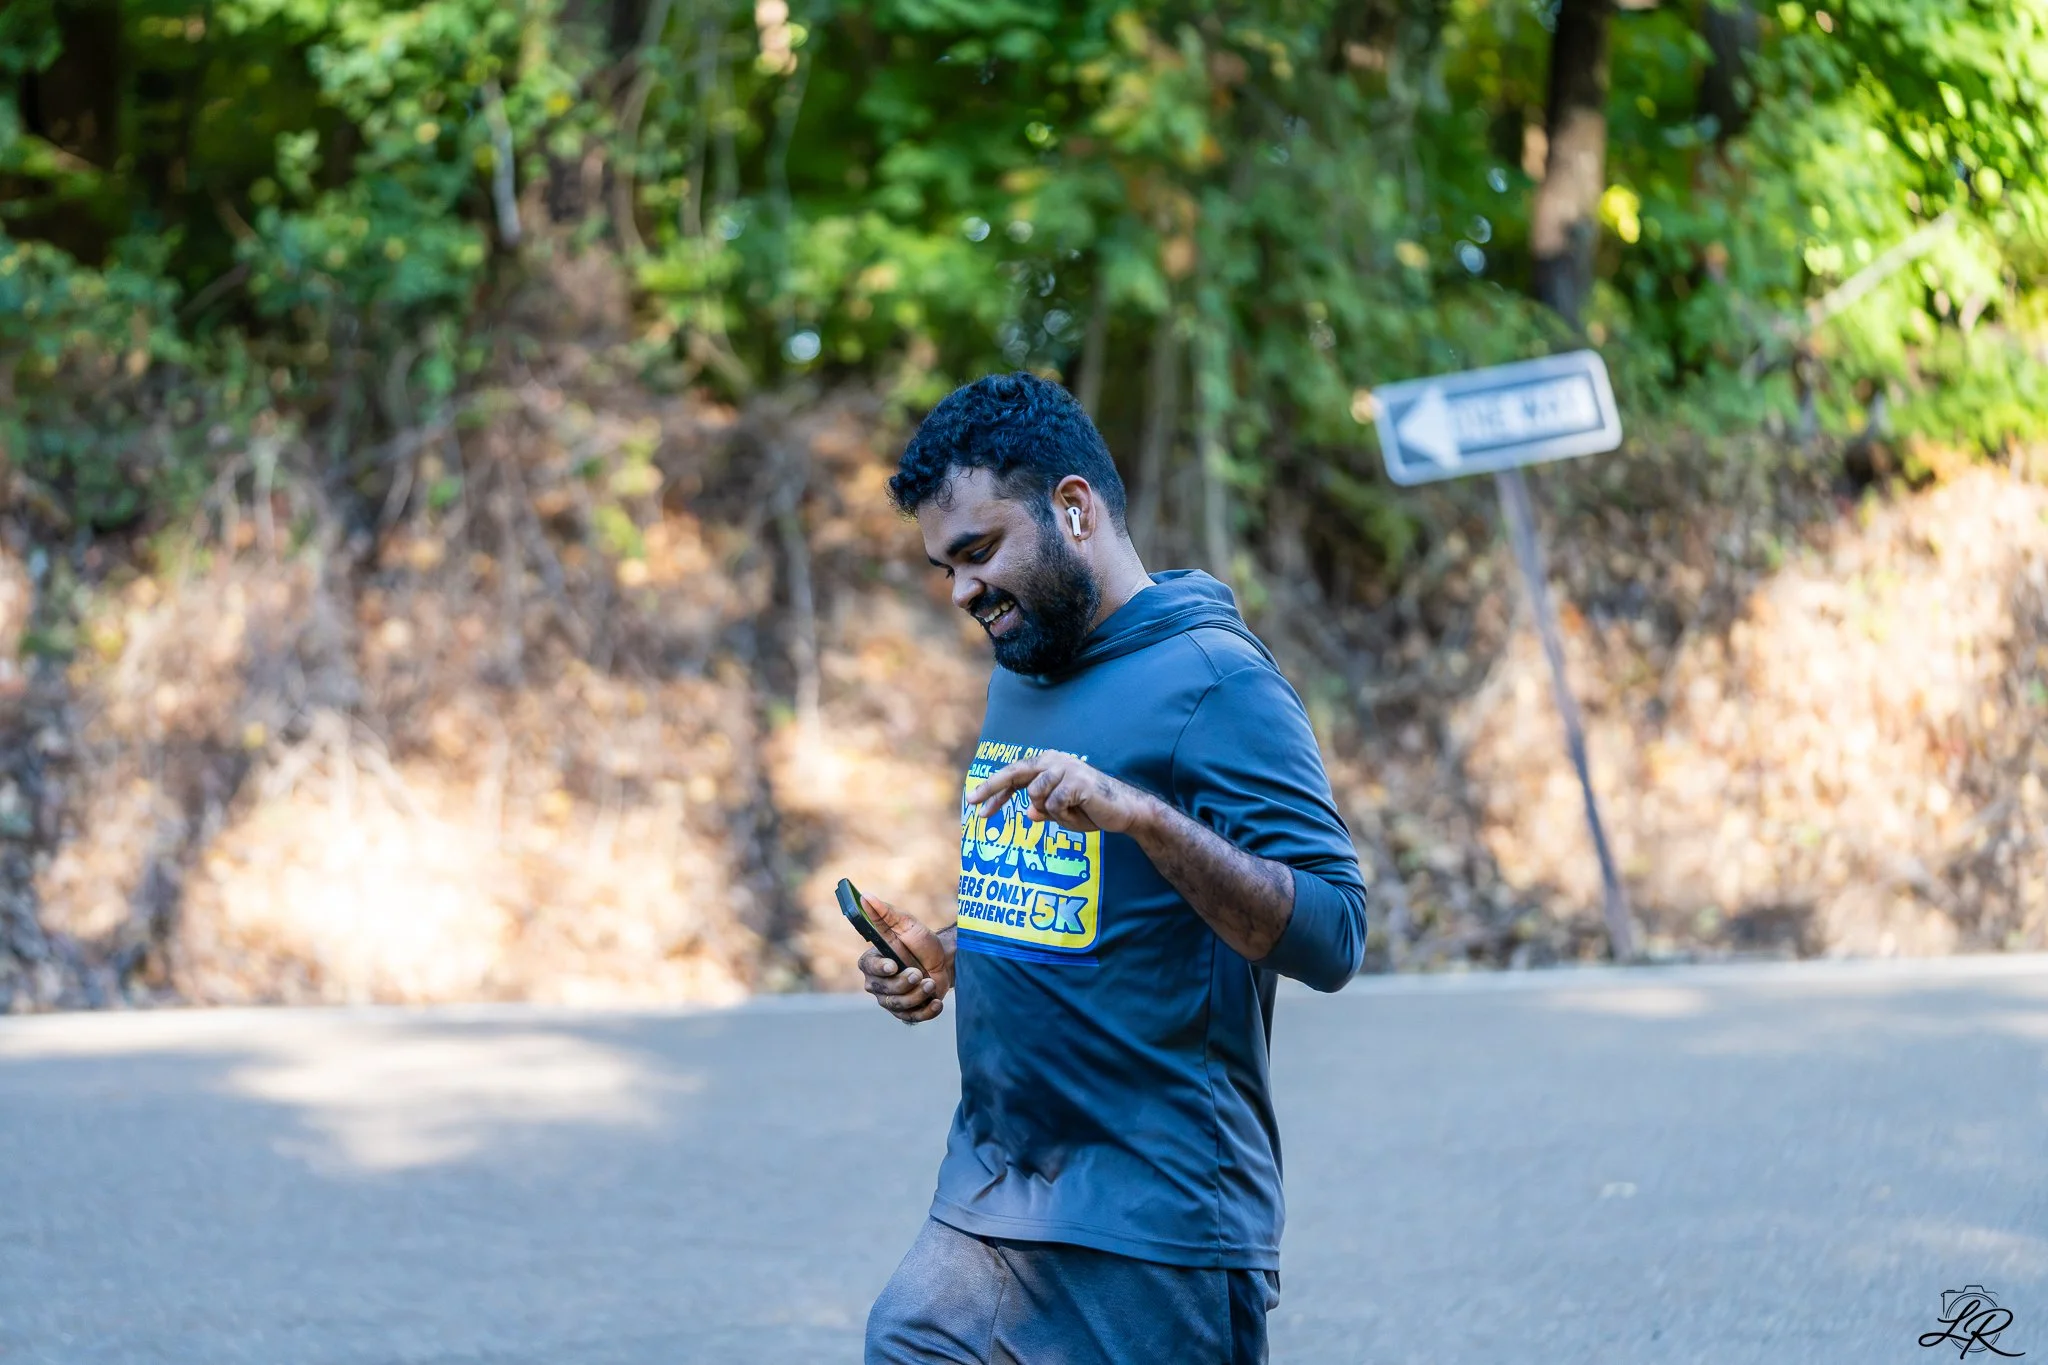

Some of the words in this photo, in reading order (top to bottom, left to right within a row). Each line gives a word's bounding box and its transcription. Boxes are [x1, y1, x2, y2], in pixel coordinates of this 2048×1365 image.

[975, 741, 1023, 764] MEMPHIS
[986, 880, 1034, 907] ONLY
[958, 899, 1027, 928] XPERIENCE
[1030, 890, 1089, 935] 5K
